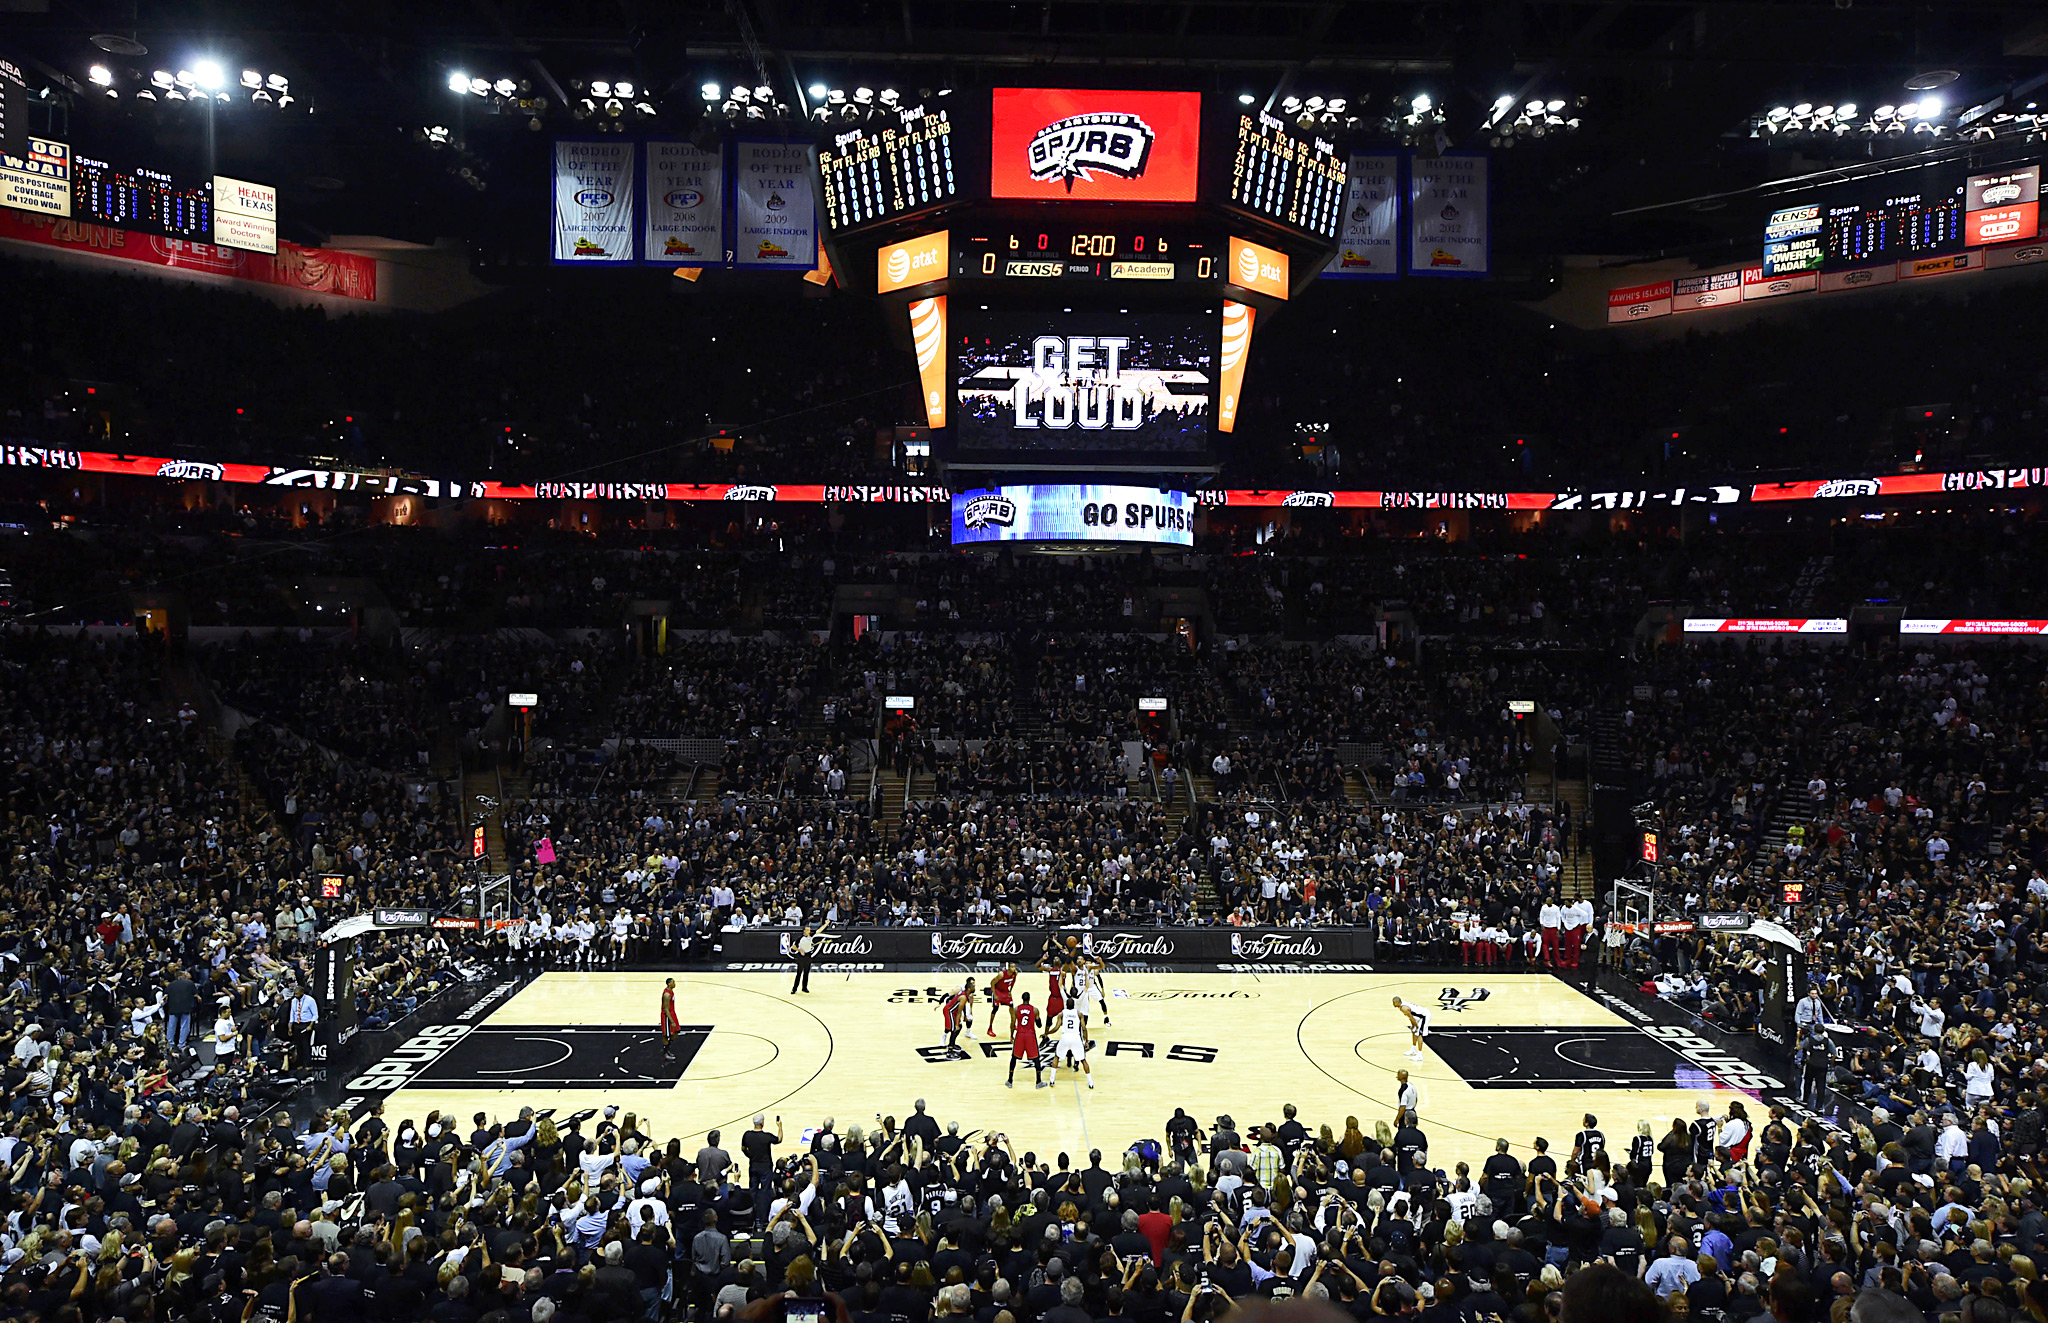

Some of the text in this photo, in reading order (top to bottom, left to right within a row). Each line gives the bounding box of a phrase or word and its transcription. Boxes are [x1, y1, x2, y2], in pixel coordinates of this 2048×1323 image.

[900, 104, 925, 124] Heat
[1259, 110, 1284, 132] Spurs
[882, 114, 939, 142] FG: TO:
[835, 129, 862, 147] Spurs
[886, 122, 951, 154] PL PT FL AS RB
[571, 146, 620, 156] RODEO
[820, 139, 870, 164] FG: TO:
[1315, 136, 1334, 155] Heat
[35, 152, 61, 165] Radio
[752, 148, 801, 159] RODEO
[75, 155, 108, 169] Spurs
[568, 161, 620, 171] OF THE
[659, 162, 710, 172] OF THE
[821, 146, 880, 175] PL PT FL AS RB
[1426, 160, 1474, 170] RODEO
[146, 169, 172, 182] Heat
[750, 164, 802, 174] OF THE
[0, 172, 68, 193] SPURS POSTGAME
[577, 176, 613, 187] YEAR
[667, 177, 702, 187] YEAR
[758, 179, 795, 190] YEAR
[825, 174, 830, 185] 2
[1358, 176, 1386, 184] THE
[1424, 175, 1476, 184] OF THE
[14, 186, 54, 200] COVERAGE
[238, 186, 274, 202] HEALTH
[825, 185, 834, 197] 21
[1432, 189, 1468, 199] YEAR
[7, 194, 62, 210] ON 1200 WOAI
[239, 196, 274, 212] TEXAS
[581, 192, 609, 204] prca
[826, 196, 836, 208] 22
[894, 198, 904, 210] 15
[1894, 194, 1921, 205] Heat
[583, 212, 605, 222] 2007
[673, 212, 696, 222] 2008
[1830, 206, 1860, 217] Spurs
[216, 216, 274, 234] Award Winning
[765, 214, 788, 224] 2009
[562, 224, 590, 232] LARGE
[652, 224, 716, 232] LARGE INDOOR
[744, 227, 808, 236] LARGE INDOOR
[1350, 226, 1372, 235] 2011
[1439, 224, 1462, 233] 2012
[1769, 226, 1820, 239] WEATHER
[1771, 220, 1816, 232] FIRST ALERT
[230, 228, 261, 240] Doctors
[216, 236, 274, 252] HEALTHTEXAS.ORG
[1038, 234, 1144, 256] 0 12:00 0
[1357, 238, 1391, 246] INDOOR
[1771, 238, 1818, 254] SA's MOST
[912, 246, 938, 269] at&t
[1766, 247, 1822, 264] POWERFUL
[983, 252, 996, 274] 0
[1069, 265, 1090, 274] PERIOD
[1197, 256, 1212, 279] 0
[1774, 260, 1807, 273] RADAR
[1916, 260, 1952, 272] HOLT
[1128, 264, 1172, 276] Academy
[1260, 264, 1282, 284] at&t
[1678, 271, 1738, 288] BONNER'S WICKED
[1676, 278, 1739, 295] AWESOME SECTION
[1609, 286, 1671, 302] KAWHI'S ISLAND
[1032, 336, 1130, 379] GET
[1014, 382, 1144, 430] LOUD
[1084, 502, 1184, 531] GO SPURS
[474, 838, 483, 858] 24
[1643, 842, 1657, 862] 24
[322, 878, 342, 887] 12:00
[1784, 883, 1803, 892] 12:00
[322, 886, 339, 897] 24
[1786, 892, 1800, 902] 24
[395, 911, 422, 922] Finals
[1716, 916, 1744, 926] Finals
[941, 932, 1024, 956] The Finals
[1092, 933, 1174, 956] The Finals
[1240, 933, 1322, 956] The Finals
[726, 962, 884, 971] spur.com
[1216, 962, 1374, 972] spurs.com
[456, 979, 520, 1020] BASKETBALL
[1164, 988, 1260, 1000] Finals
[1600, 994, 1654, 1022] ANTONIO
[1020, 1015, 1029, 1026] 6
[1066, 1020, 1074, 1030] 2
[345, 1025, 472, 1090] SPURS
[1642, 1026, 1786, 1090] SPURS
[890, 1201, 907, 1218] 21
[931, 1200, 942, 1216] 9
[1460, 1204, 1476, 1220] 20
